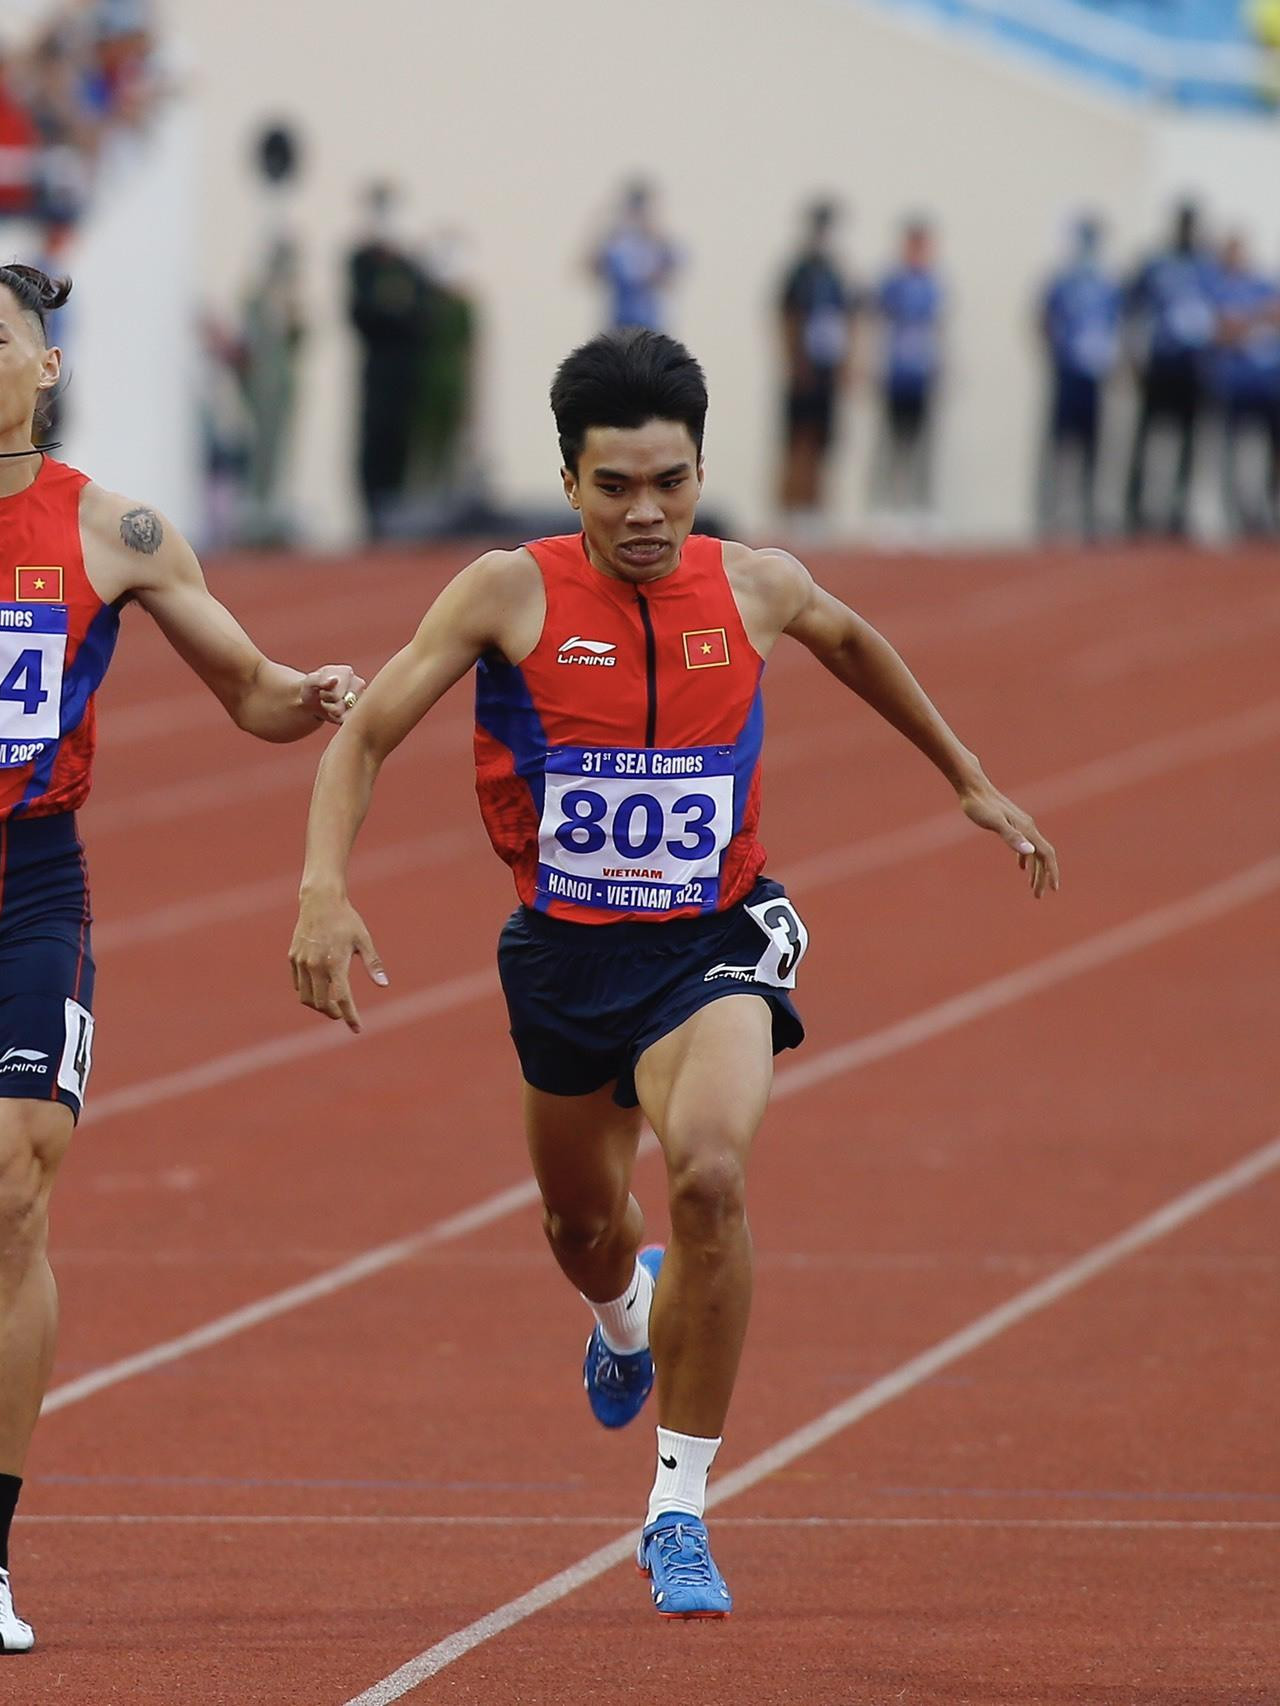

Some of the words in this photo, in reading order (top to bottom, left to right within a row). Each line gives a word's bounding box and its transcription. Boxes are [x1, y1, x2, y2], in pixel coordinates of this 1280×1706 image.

[557, 653, 616, 667] LI-NING
[615, 754, 647, 774] SEA
[652, 754, 703, 774] Games
[554, 790, 717, 861] 803
[602, 868, 663, 879] VIETNAM
[548, 874, 593, 902] HANOI
[607, 885, 672, 910] VIETNAM
[673, 883, 703, 905] 022
